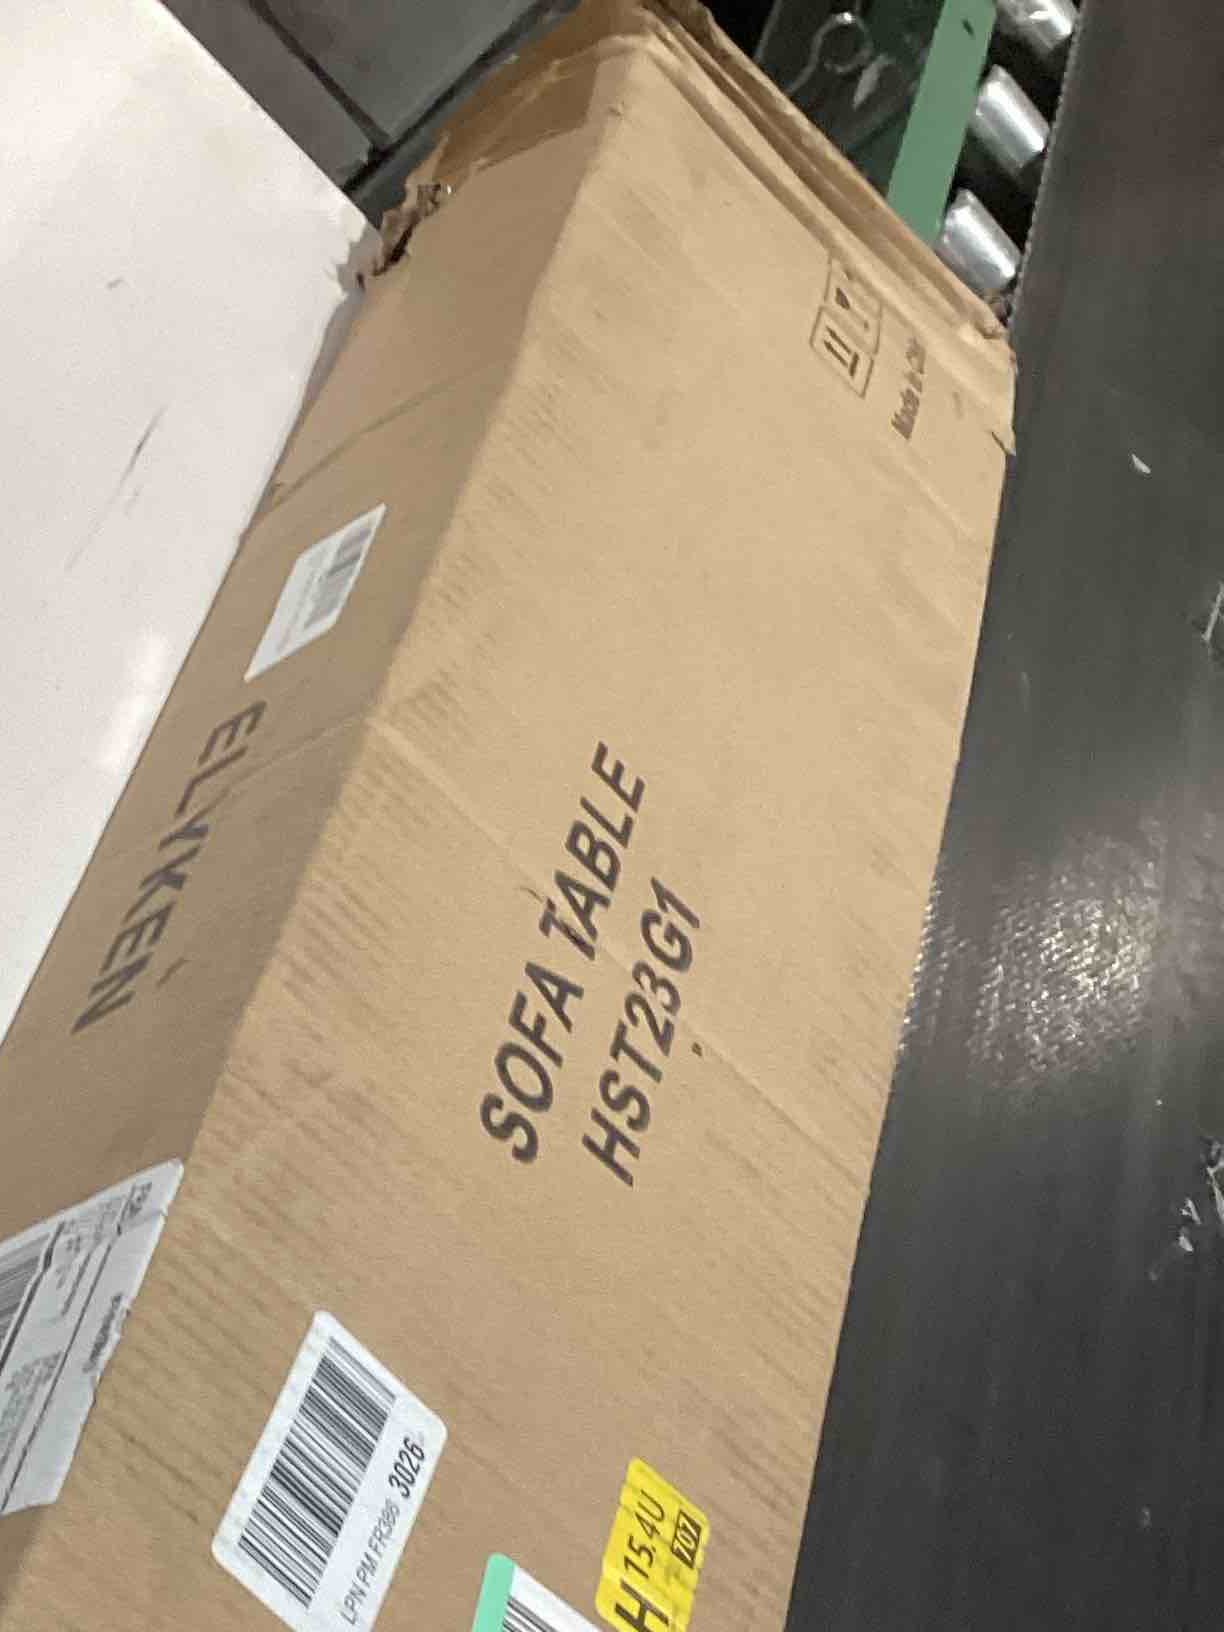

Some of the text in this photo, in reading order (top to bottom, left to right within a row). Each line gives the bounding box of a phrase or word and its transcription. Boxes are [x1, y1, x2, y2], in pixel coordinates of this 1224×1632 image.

[70, 700, 267, 1036] ELYKEN
[479, 740, 646, 1165] SOFA TABLE
[581, 875, 701, 1188] HST23G1
[387, 1436, 426, 1499] 3026
[623, 1489, 667, 1581] 15.4U
[673, 1513, 701, 1567] 707
